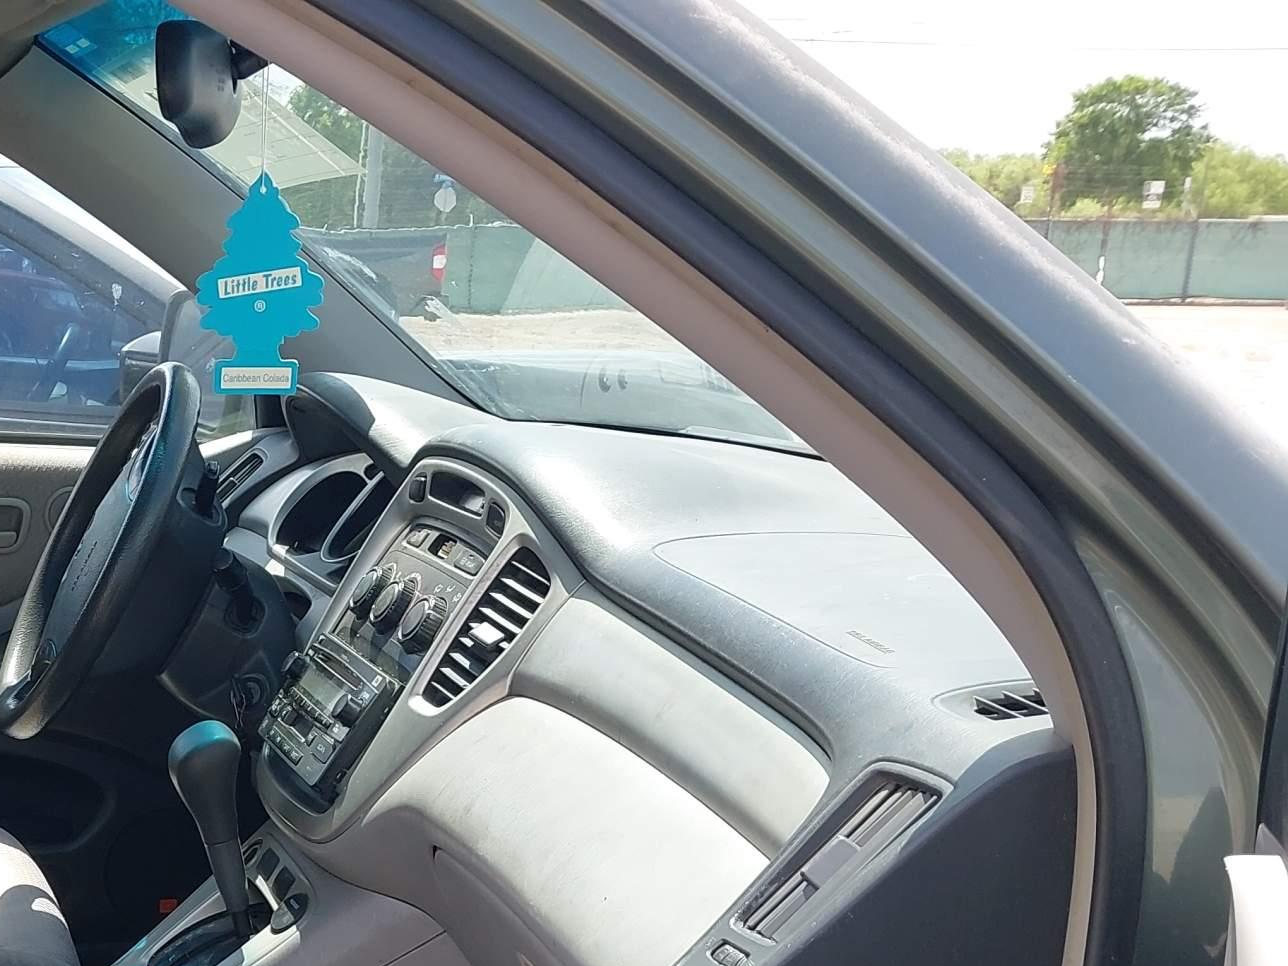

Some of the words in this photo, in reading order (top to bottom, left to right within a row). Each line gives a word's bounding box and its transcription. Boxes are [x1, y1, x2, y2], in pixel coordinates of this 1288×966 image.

[224, 276, 258, 296] Little
[262, 273, 297, 289] Trees
[223, 373, 261, 384] Caribbean
[262, 373, 290, 384] Colada
